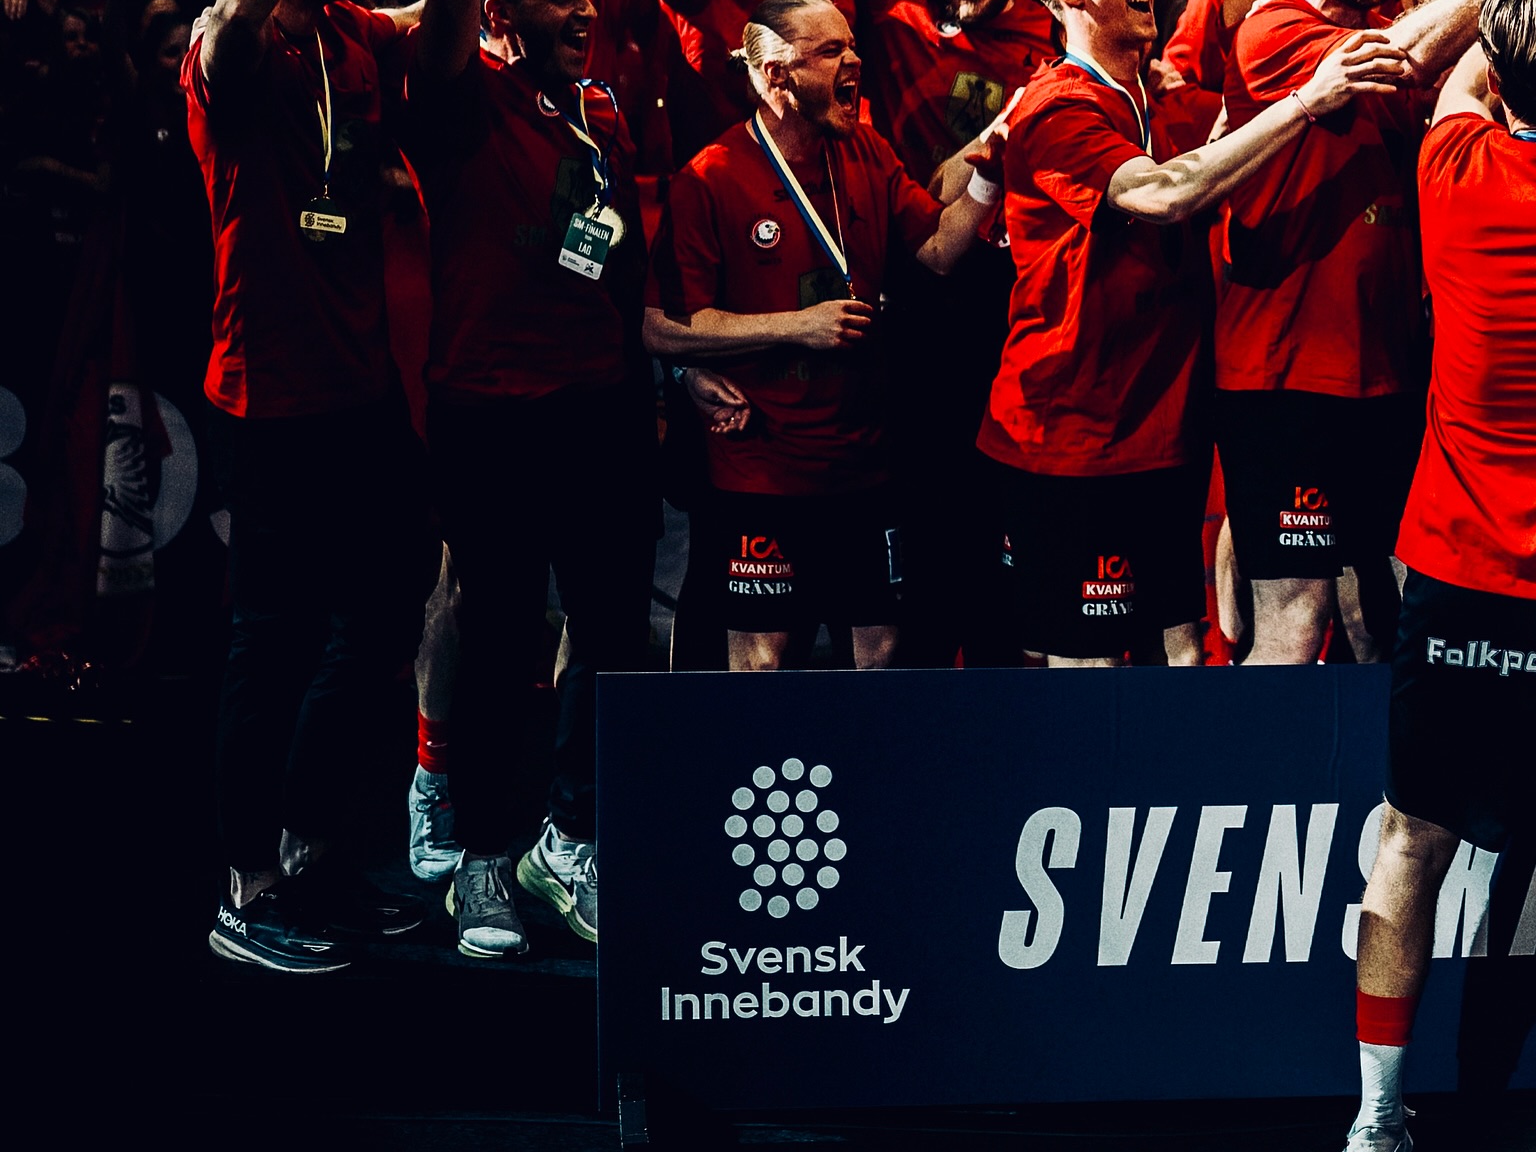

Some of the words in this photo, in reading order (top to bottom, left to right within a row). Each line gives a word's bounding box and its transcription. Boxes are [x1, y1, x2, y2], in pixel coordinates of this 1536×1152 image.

[572, 217, 610, 241] SM-FINALEN
[1294, 486, 1330, 511] ICA
[1282, 513, 1333, 526] KVANTU
[740, 534, 785, 560] ICA
[731, 561, 792, 575] KVANTUM
[1096, 554, 1134, 580] ICA
[217, 905, 247, 937] HOKA
[700, 936, 866, 976] Svensk
[660, 978, 911, 1025] Innebandy
